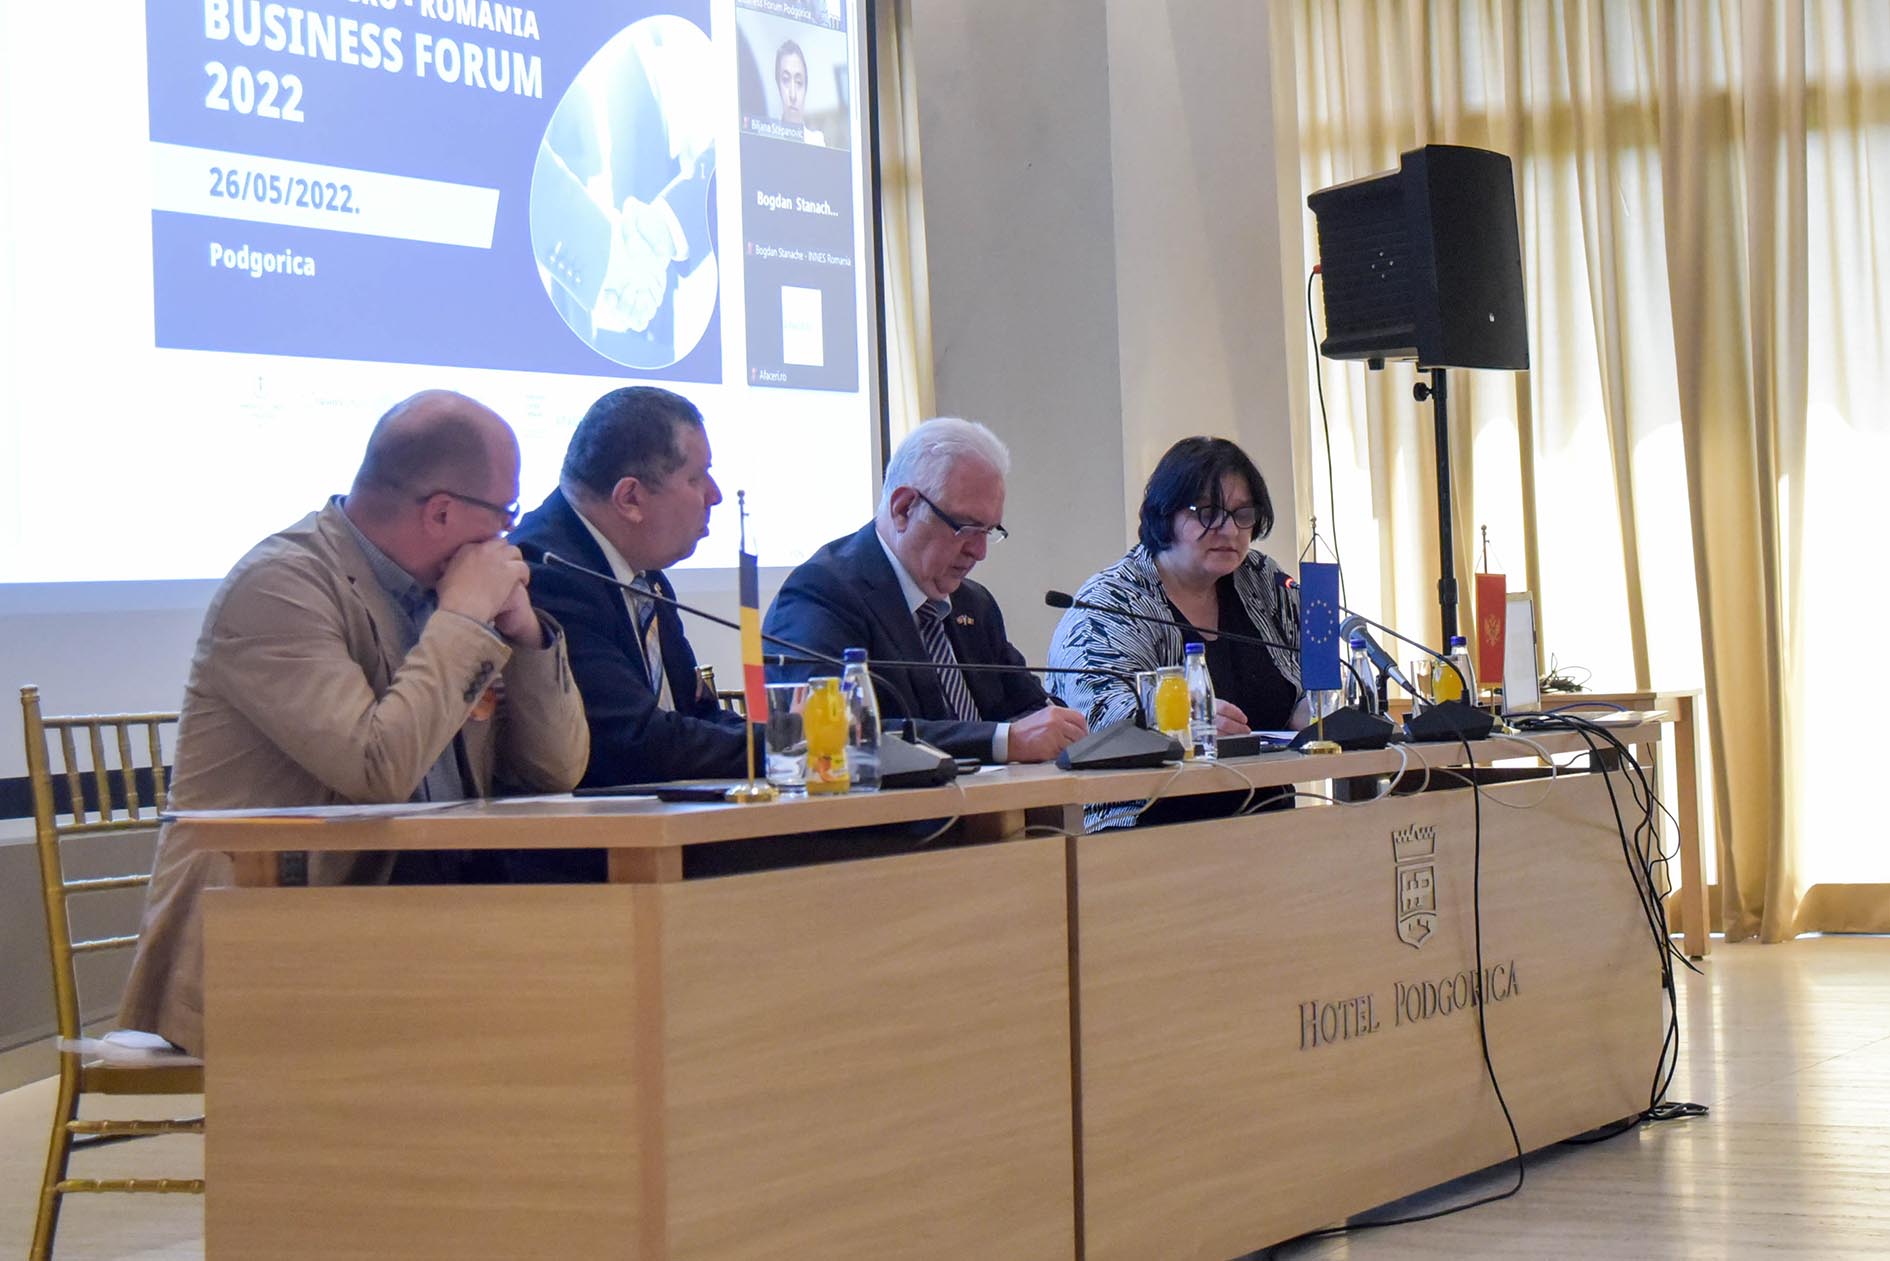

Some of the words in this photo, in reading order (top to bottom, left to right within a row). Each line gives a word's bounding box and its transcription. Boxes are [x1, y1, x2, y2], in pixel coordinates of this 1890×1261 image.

[421, 0, 540, 40] ROMANIA
[204, 0, 404, 73] BUSINESS
[415, 32, 543, 99] FORUM
[204, 61, 304, 122] 2022
[209, 166, 360, 214] 26/05/2022.
[757, 190, 793, 211] Bogdan
[796, 196, 839, 217] Stanach...
[209, 241, 316, 278] Podgorica
[755, 244, 778, 259] Bogdan
[1299, 993, 1381, 1051] HOTEL
